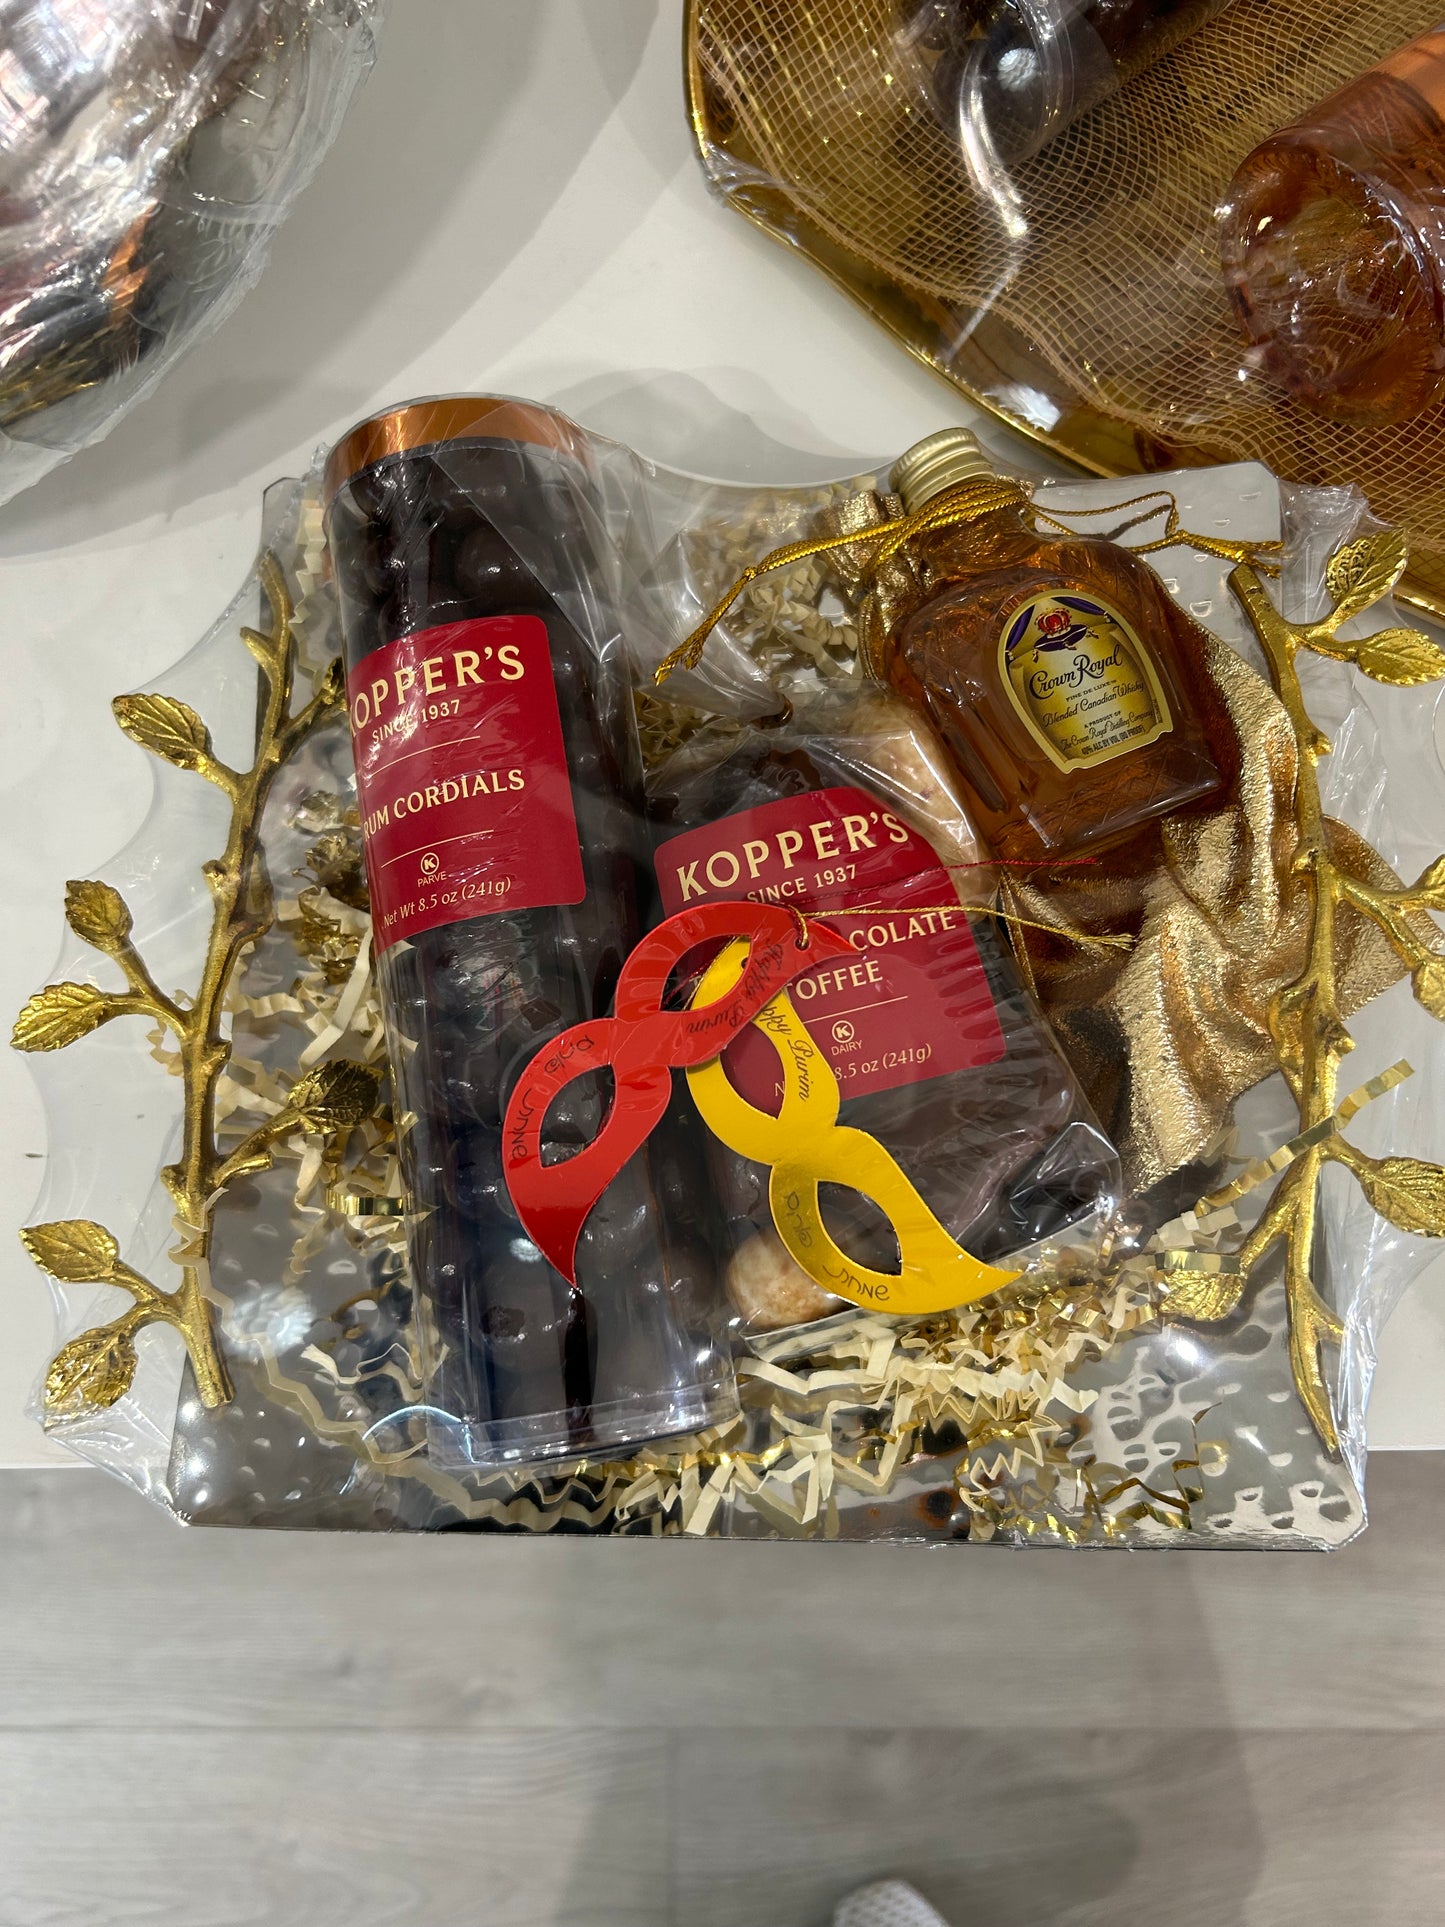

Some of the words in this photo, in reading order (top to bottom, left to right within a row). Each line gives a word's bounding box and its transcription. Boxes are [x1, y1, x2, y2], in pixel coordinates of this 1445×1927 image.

[350, 645, 525, 738] OPPER'S
[1029, 670, 1077, 700] Crown
[1069, 644, 1122, 689] Royal
[1065, 693, 1082, 702] FINE
[1083, 688, 1093, 696] DE
[372, 714, 413, 746] SINCE
[421, 699, 461, 724] 1937
[1042, 703, 1079, 728] Blended
[1080, 691, 1117, 711] Canadian
[1113, 681, 1144, 697] Whisky
[1089, 714, 1113, 726] PRODUCT
[363, 807, 389, 843] RUM
[393, 769, 525, 819] CORDIALS
[417, 870, 448, 888] PARVE
[675, 811, 910, 902] KOPPER'S
[383, 910, 398, 930] Net
[399, 902, 416, 919] Wt
[418, 895, 438, 913] 8.5
[441, 889, 458, 906] oz
[461, 876, 512, 900] (241g)
[747, 877, 807, 903] SINCE
[816, 864, 857, 888] 1937
[849, 911, 957, 953] COLATE
[744, 938, 785, 1002] Happy
[686, 1005, 746, 1035] Purim
[760, 1004, 793, 1036] ppy
[787, 1039, 815, 1103] Purim
[831, 1040, 863, 1056] DAIRY
[834, 1064, 857, 1081] 8.5
[860, 1058, 879, 1074] oz
[882, 1043, 933, 1070] (241g)
